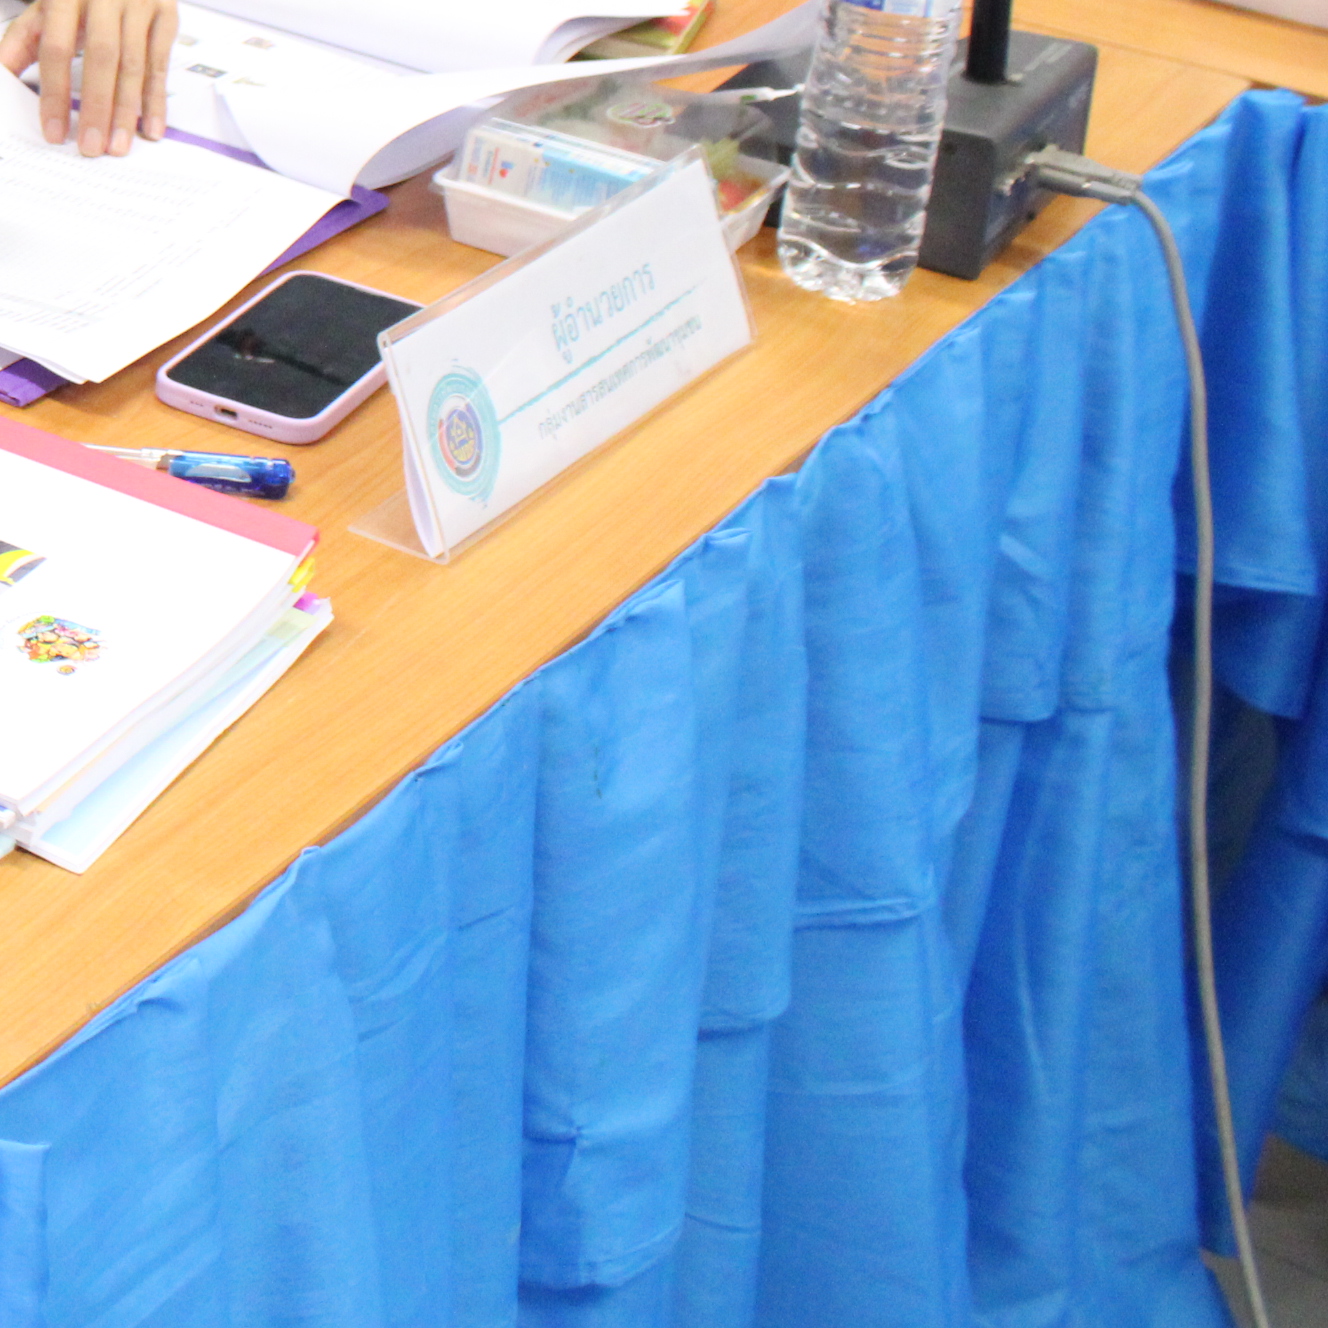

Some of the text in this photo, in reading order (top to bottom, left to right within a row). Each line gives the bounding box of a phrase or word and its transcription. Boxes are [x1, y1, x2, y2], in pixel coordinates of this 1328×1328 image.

[550, 262, 656, 364] ผู้อำนวยการ
